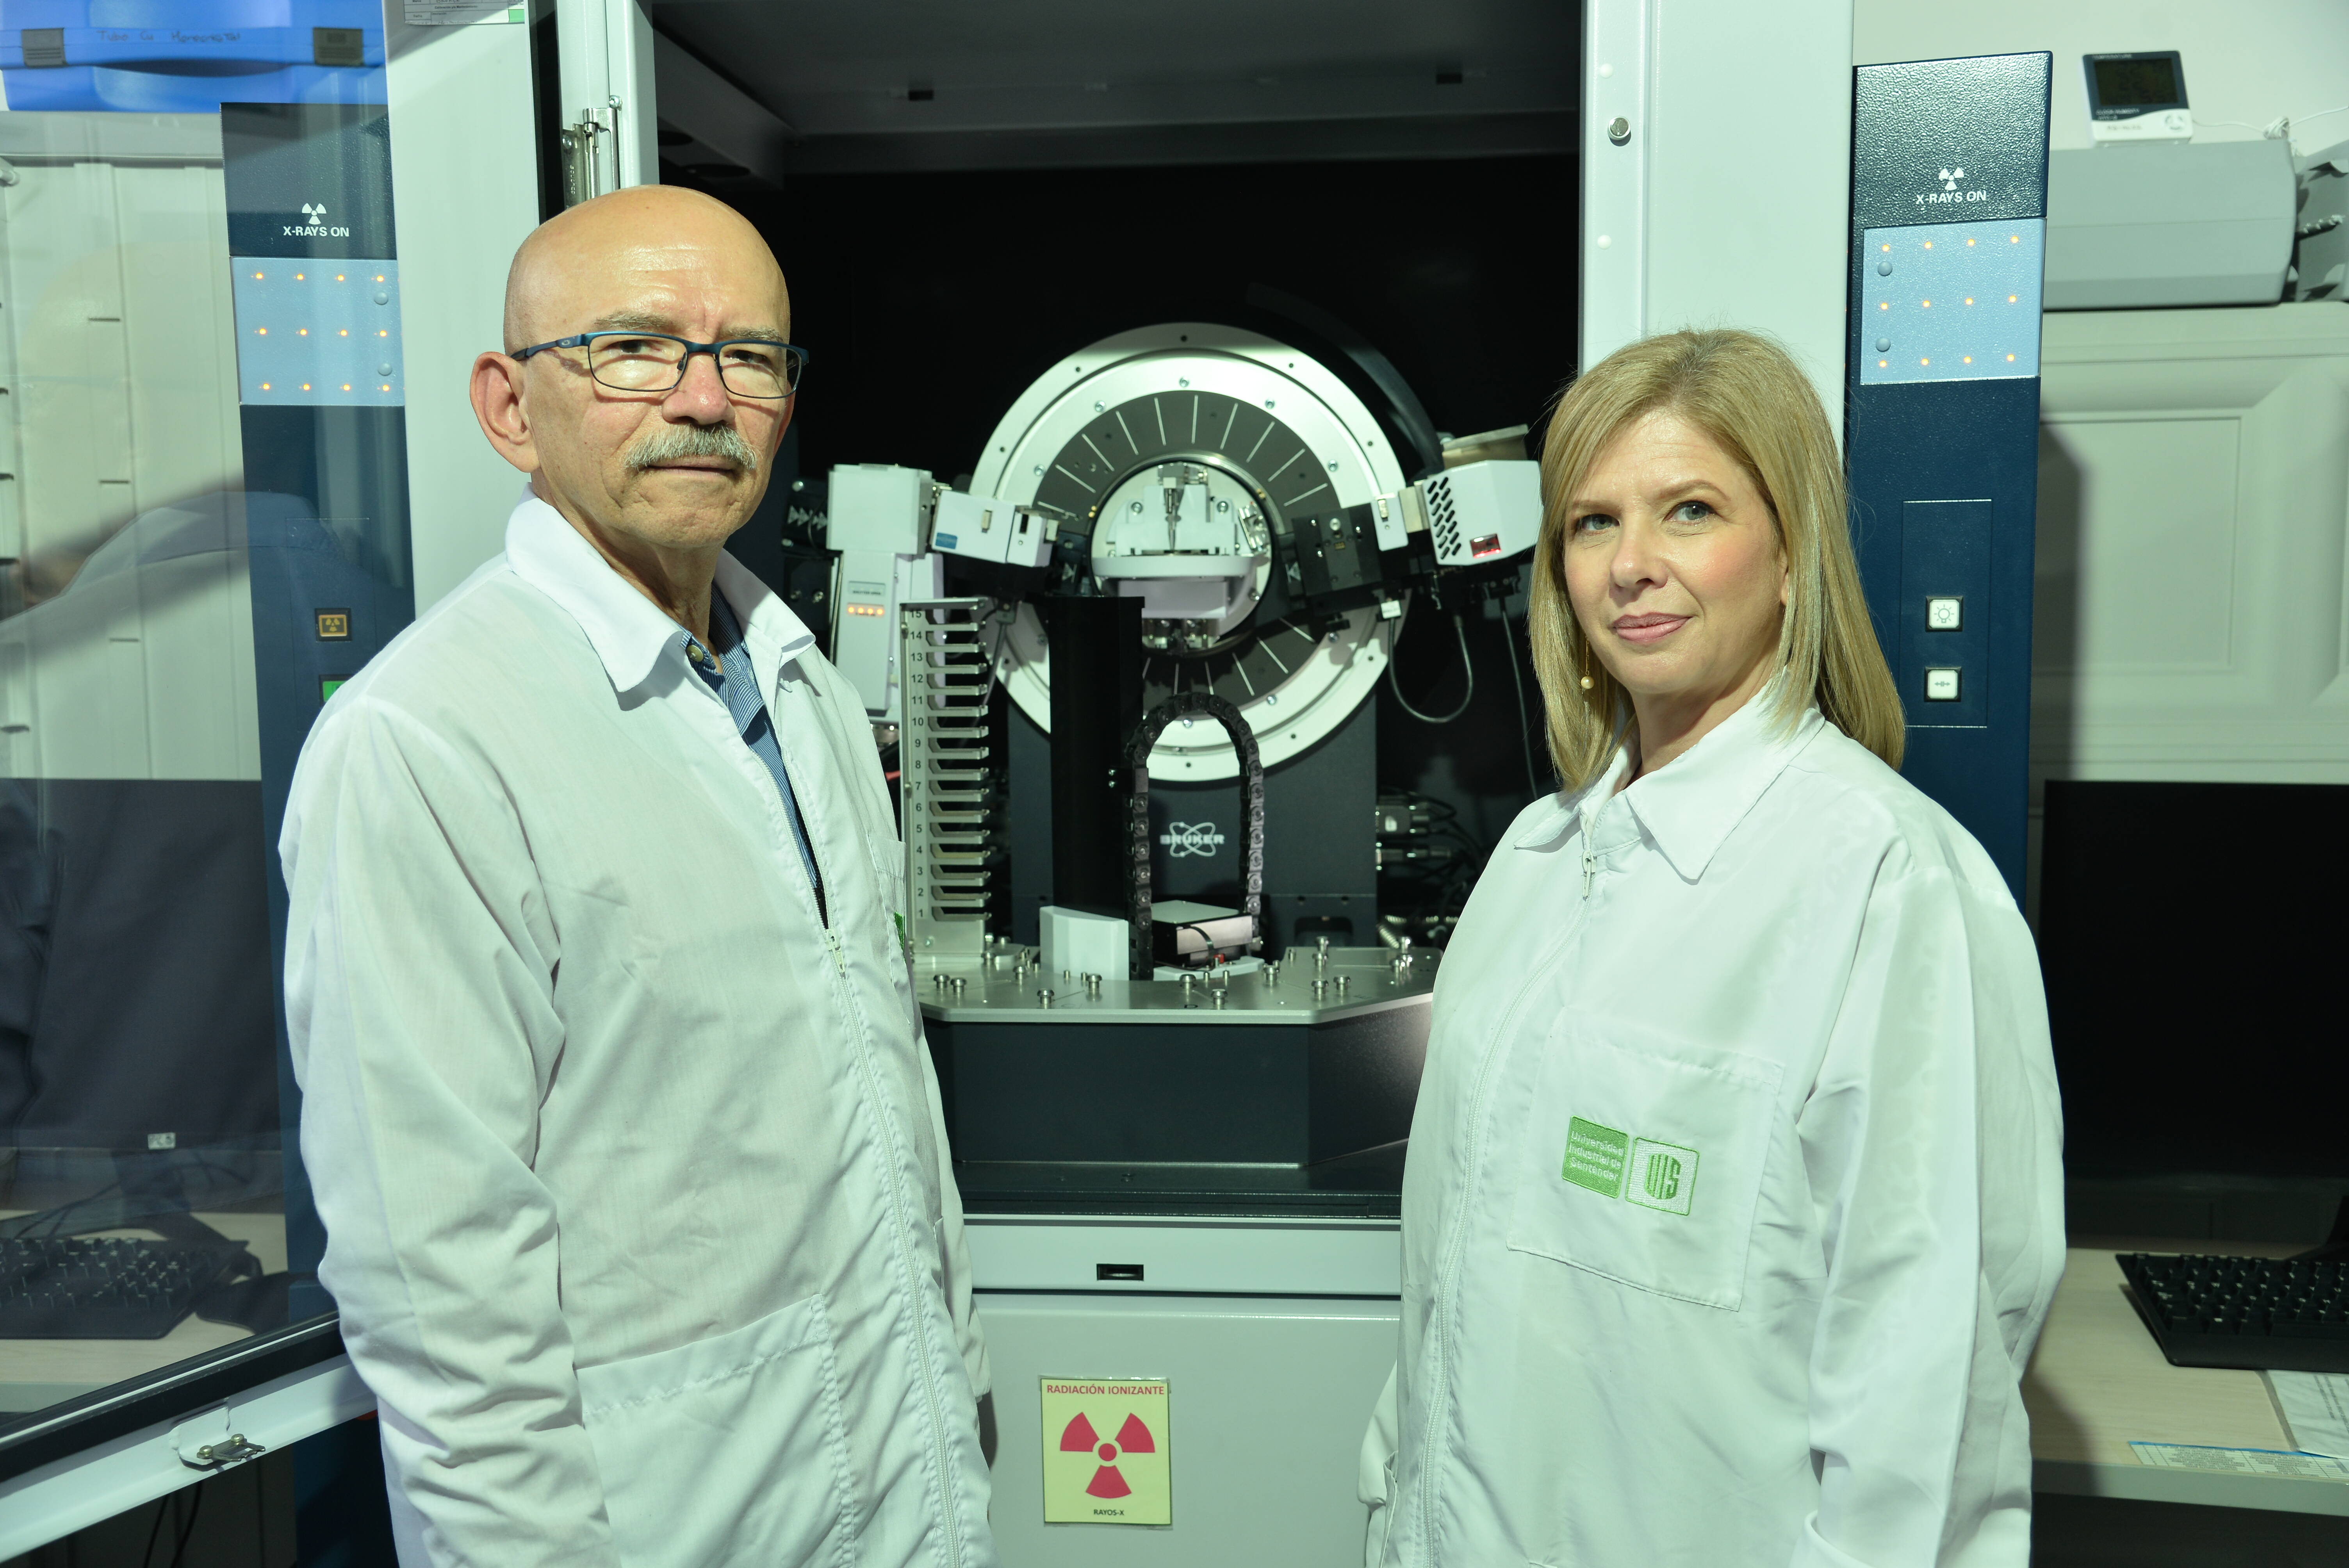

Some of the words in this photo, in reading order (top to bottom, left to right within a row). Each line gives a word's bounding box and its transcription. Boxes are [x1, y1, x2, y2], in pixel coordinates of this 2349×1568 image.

[1916, 191, 1963, 205] X-RAYS
[1966, 190, 1987, 202] ON
[283, 226, 328, 237] X-RAYS
[330, 226, 349, 237] ON
[911, 610, 922, 618] 15
[910, 631, 922, 640] 14
[911, 652, 923, 661] 13
[911, 674, 923, 683] 12
[912, 695, 923, 704] 11
[912, 717, 924, 726] 10
[915, 739, 921, 748] 9
[915, 760, 921, 769] 8
[915, 782, 921, 790] 7
[916, 803, 922, 812] 6
[916, 824, 922, 833] 5
[916, 845, 922, 854] 4
[917, 866, 923, 875] 3
[918, 887, 923, 896] 2
[918, 909, 923, 917] 1
[1571, 1131, 1625, 1157] Universidad
[1568, 1142, 1609, 1165] Industrial
[1611, 1159, 1622, 1169] de
[1571, 1157, 1618, 1181] Santander
[1644, 1153, 1681, 1200] UIS
[1047, 1384, 1105, 1394] RADIACIÓN
[1109, 1386, 1164, 1395] IONIZANTE
